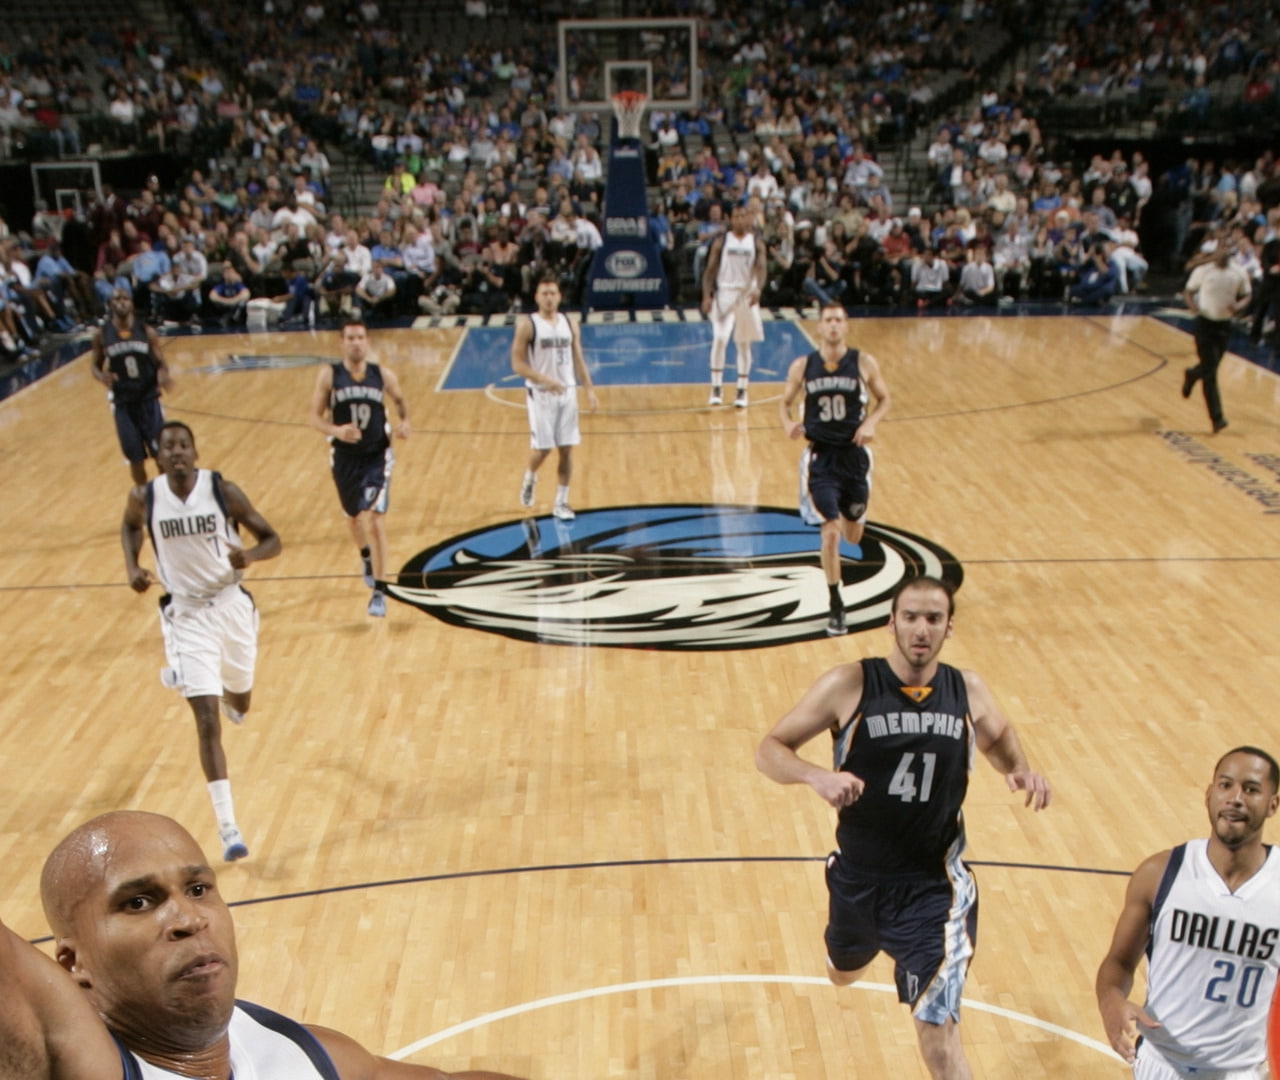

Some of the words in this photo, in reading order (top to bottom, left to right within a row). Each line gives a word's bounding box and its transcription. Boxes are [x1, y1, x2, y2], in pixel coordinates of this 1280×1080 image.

[335, 386, 384, 403] MEMPHIS
[806, 376, 858, 394] MEMPHIS
[349, 402, 372, 431] 19
[818, 394, 847, 422] 30
[158, 514, 217, 540] DALLAS
[206, 534, 222, 558] 7
[865, 711, 965, 741] MEMPHIS
[887, 752, 937, 803] 41
[1169, 908, 1280, 961] DALLAS
[1203, 960, 1266, 1009] 20
